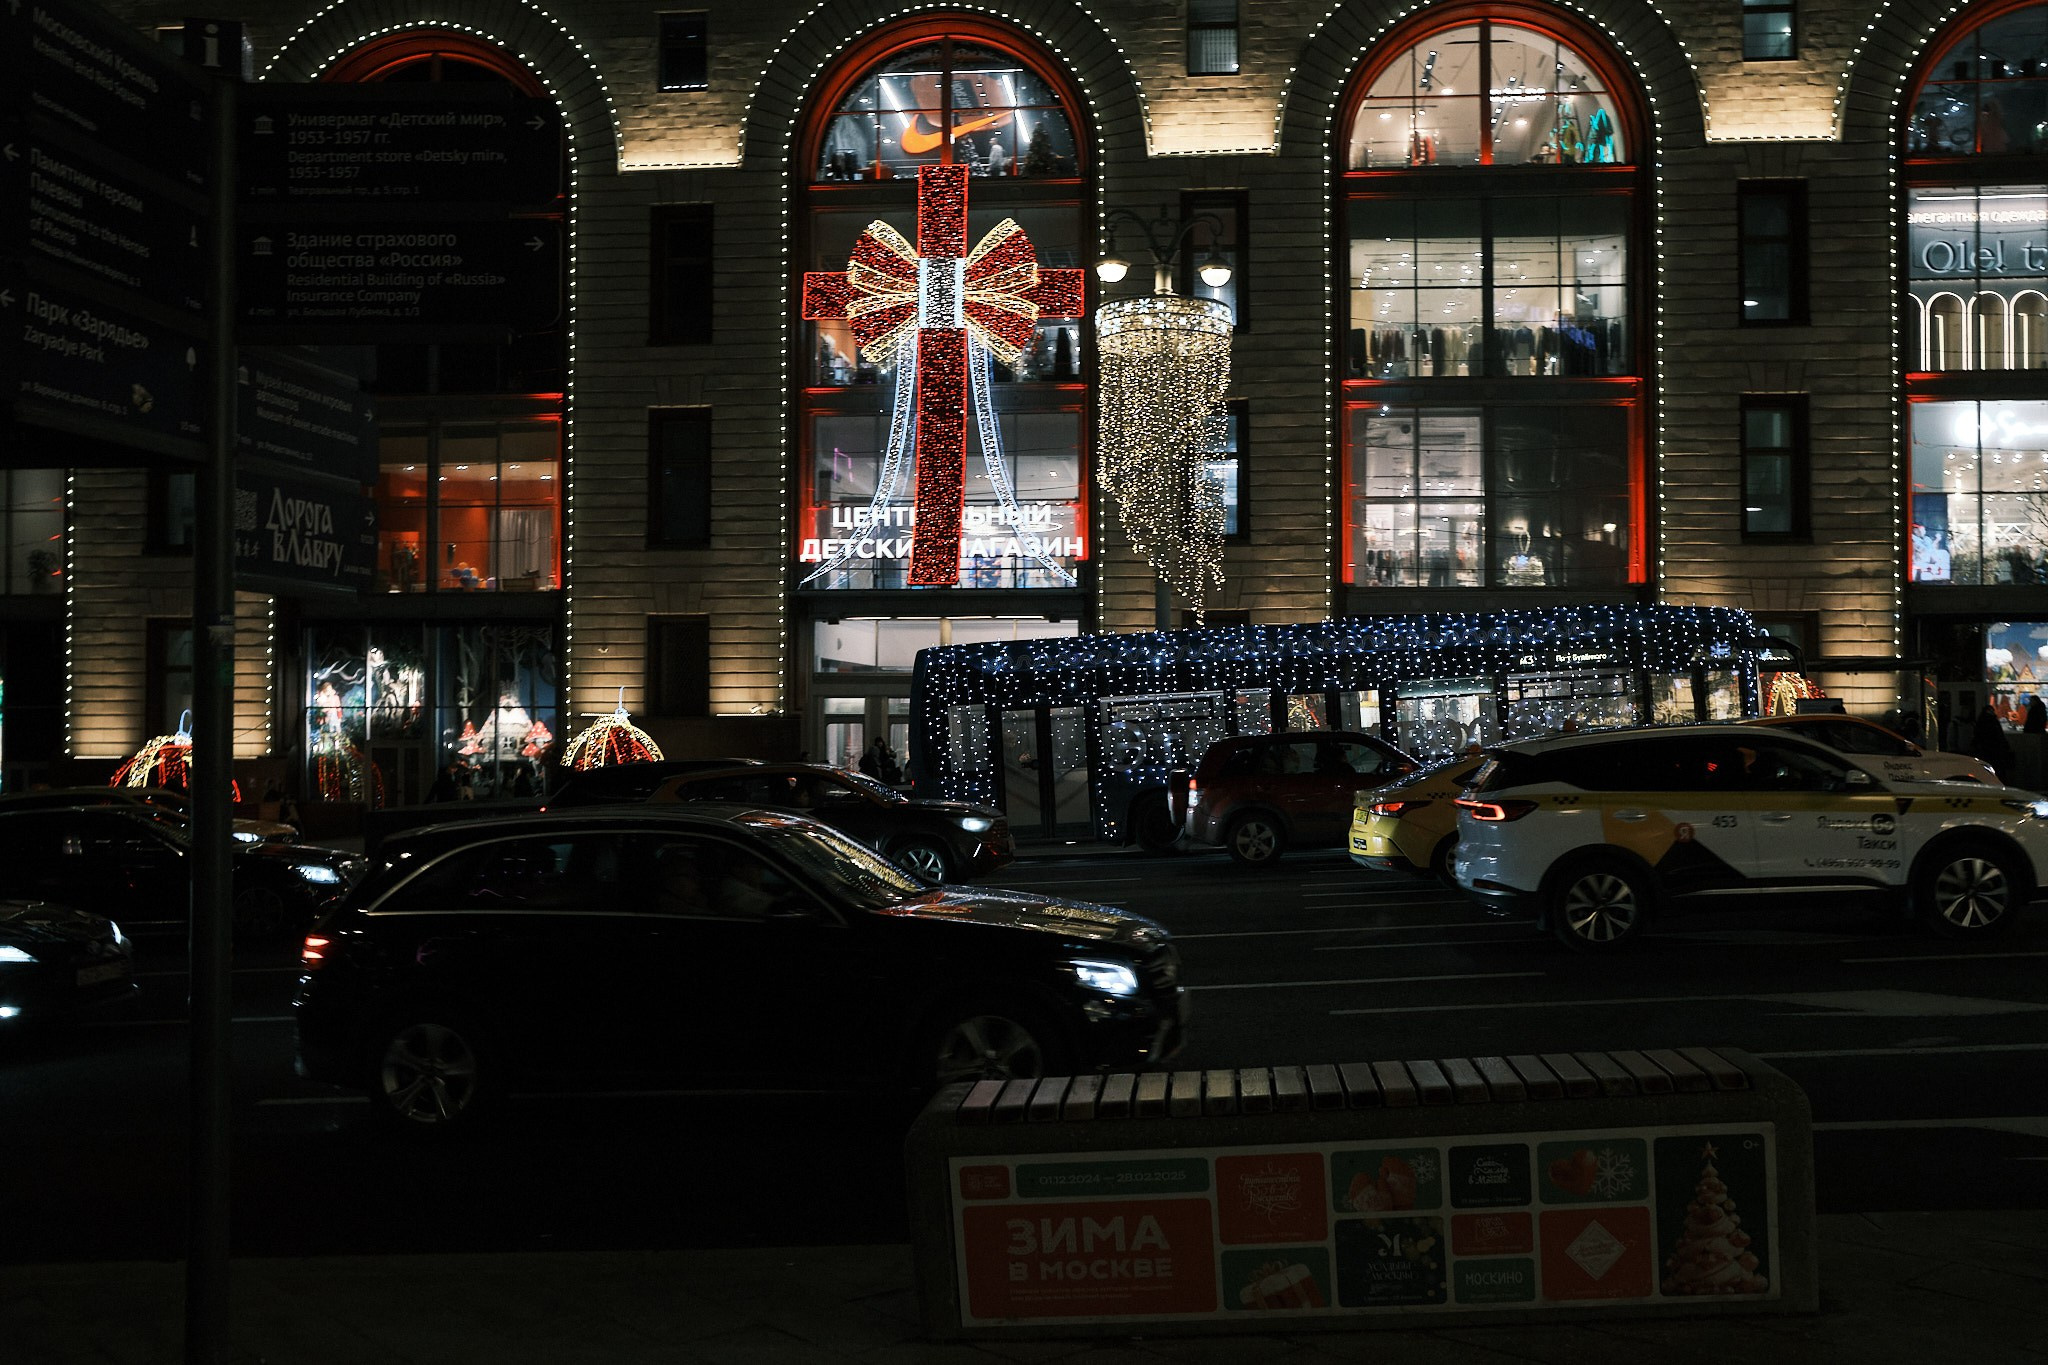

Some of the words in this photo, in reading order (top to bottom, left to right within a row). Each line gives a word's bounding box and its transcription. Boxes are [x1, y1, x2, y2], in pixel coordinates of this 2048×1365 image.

[288, 113, 377, 128] Универмаг
[380, 112, 456, 127] «Детский
[288, 131, 370, 145] 1953-1957
[288, 151, 373, 164] Department
[376, 152, 411, 163] store
[415, 151, 469, 165] «Detsky
[30, 148, 97, 193] Памятник
[288, 167, 360, 179] 1953-1957
[288, 232, 352, 249] Здание
[356, 233, 457, 250] страхового
[287, 251, 374, 268] общества
[380, 252, 463, 268] «Россия»
[288, 273, 363, 286] Residential
[367, 273, 424, 288] Building
[428, 273, 441, 285] of
[445, 273, 506, 286] «Russia»
[288, 291, 353, 302] Insurance
[357, 291, 421, 304] Company
[26, 291, 70, 325] Парк
[71, 310, 150, 349] «Зарядье»
[24, 325, 79, 357] Zaryadye
[80, 342, 105, 363] Park
[265, 487, 333, 536] Дорога
[832, 501, 1051, 529] ЦЕНТЬНЫЙ
[800, 538, 917, 563] ДЕТСКИ
[1712, 815, 1738, 828] 453
[1856, 836, 1897, 850] Такси
[1039, 1174, 1100, 1185] 01.12.2024
[1117, 1171, 1187, 1183] 28.02.2025
[1006, 1215, 1172, 1256] ЗИМА
[1008, 1262, 1029, 1282] В
[1040, 1258, 1173, 1281] МОСКВЕ
[1465, 1271, 1523, 1286] МОСКИНО
